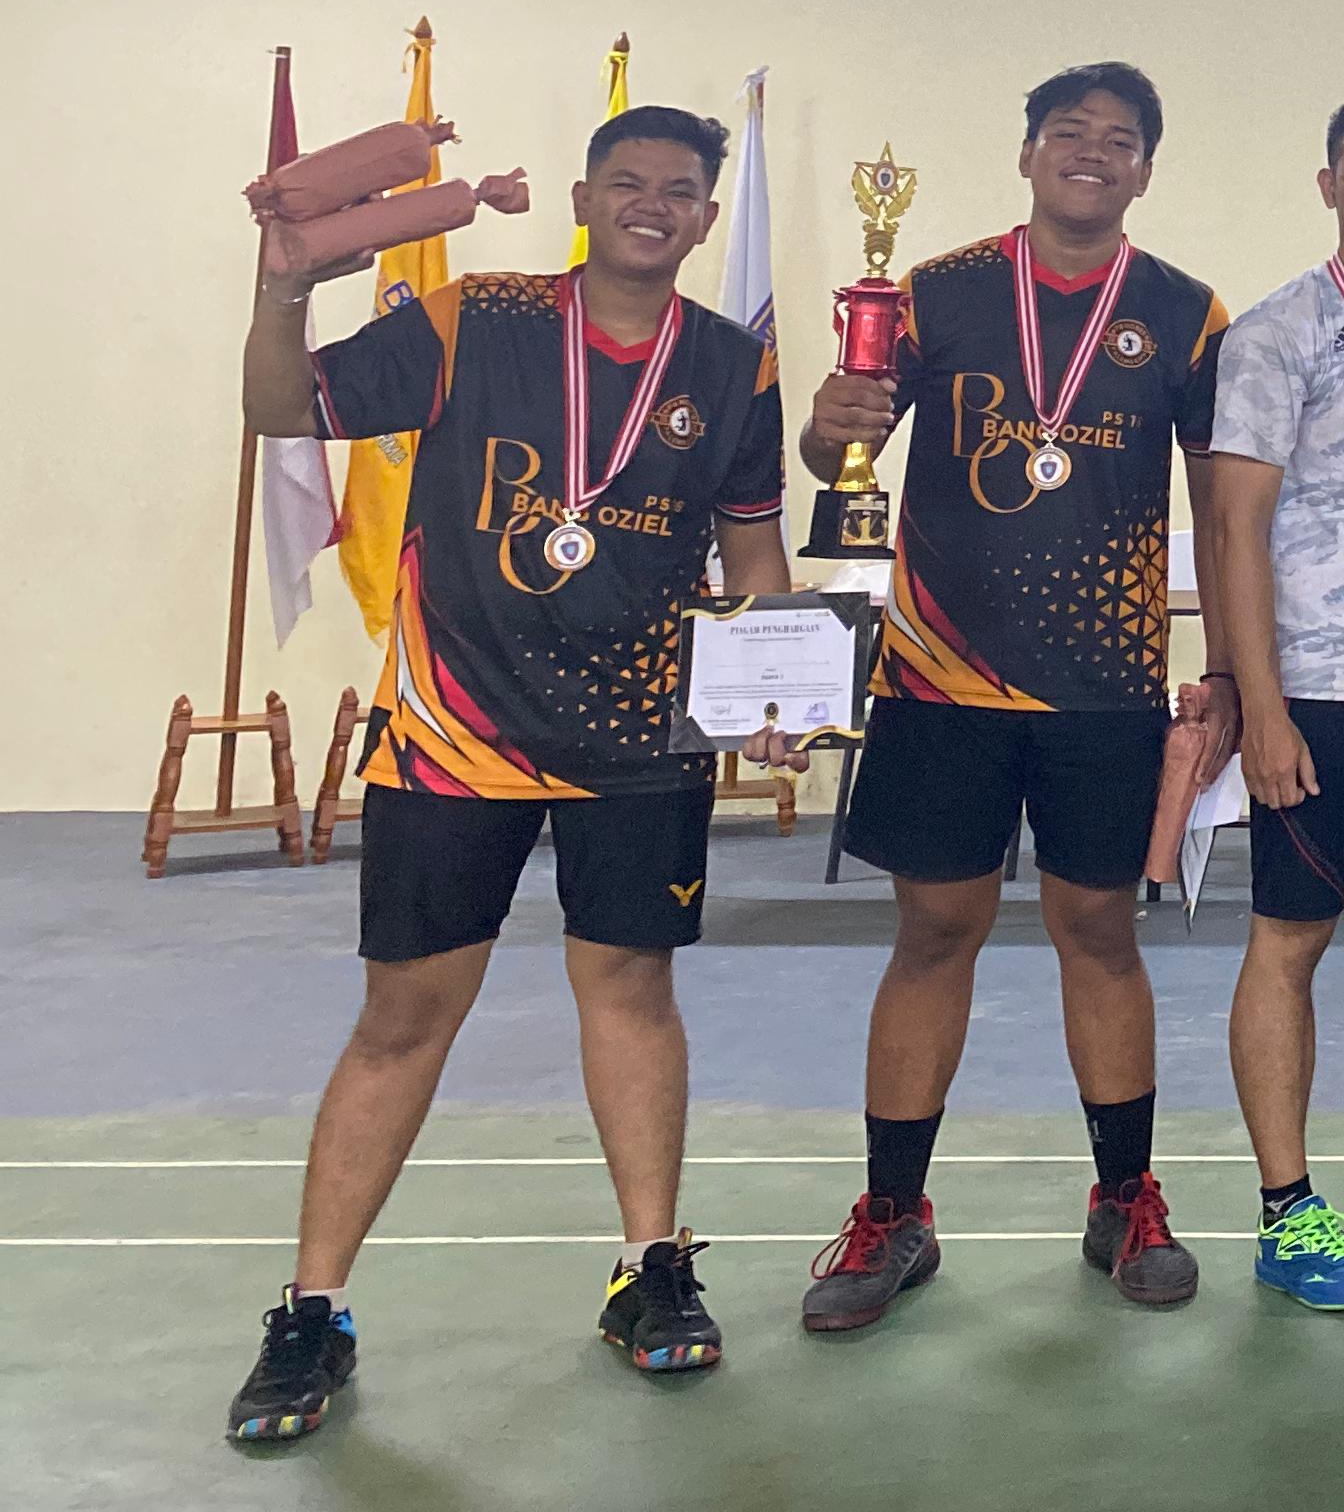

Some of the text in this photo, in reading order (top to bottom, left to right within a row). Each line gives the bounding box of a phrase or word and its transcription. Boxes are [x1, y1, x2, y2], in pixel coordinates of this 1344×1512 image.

[1103, 410, 1124, 426] PS
[1060, 423, 1126, 450] OZIEL
[644, 495, 671, 511] PS
[598, 506, 673, 536] OZIEL
